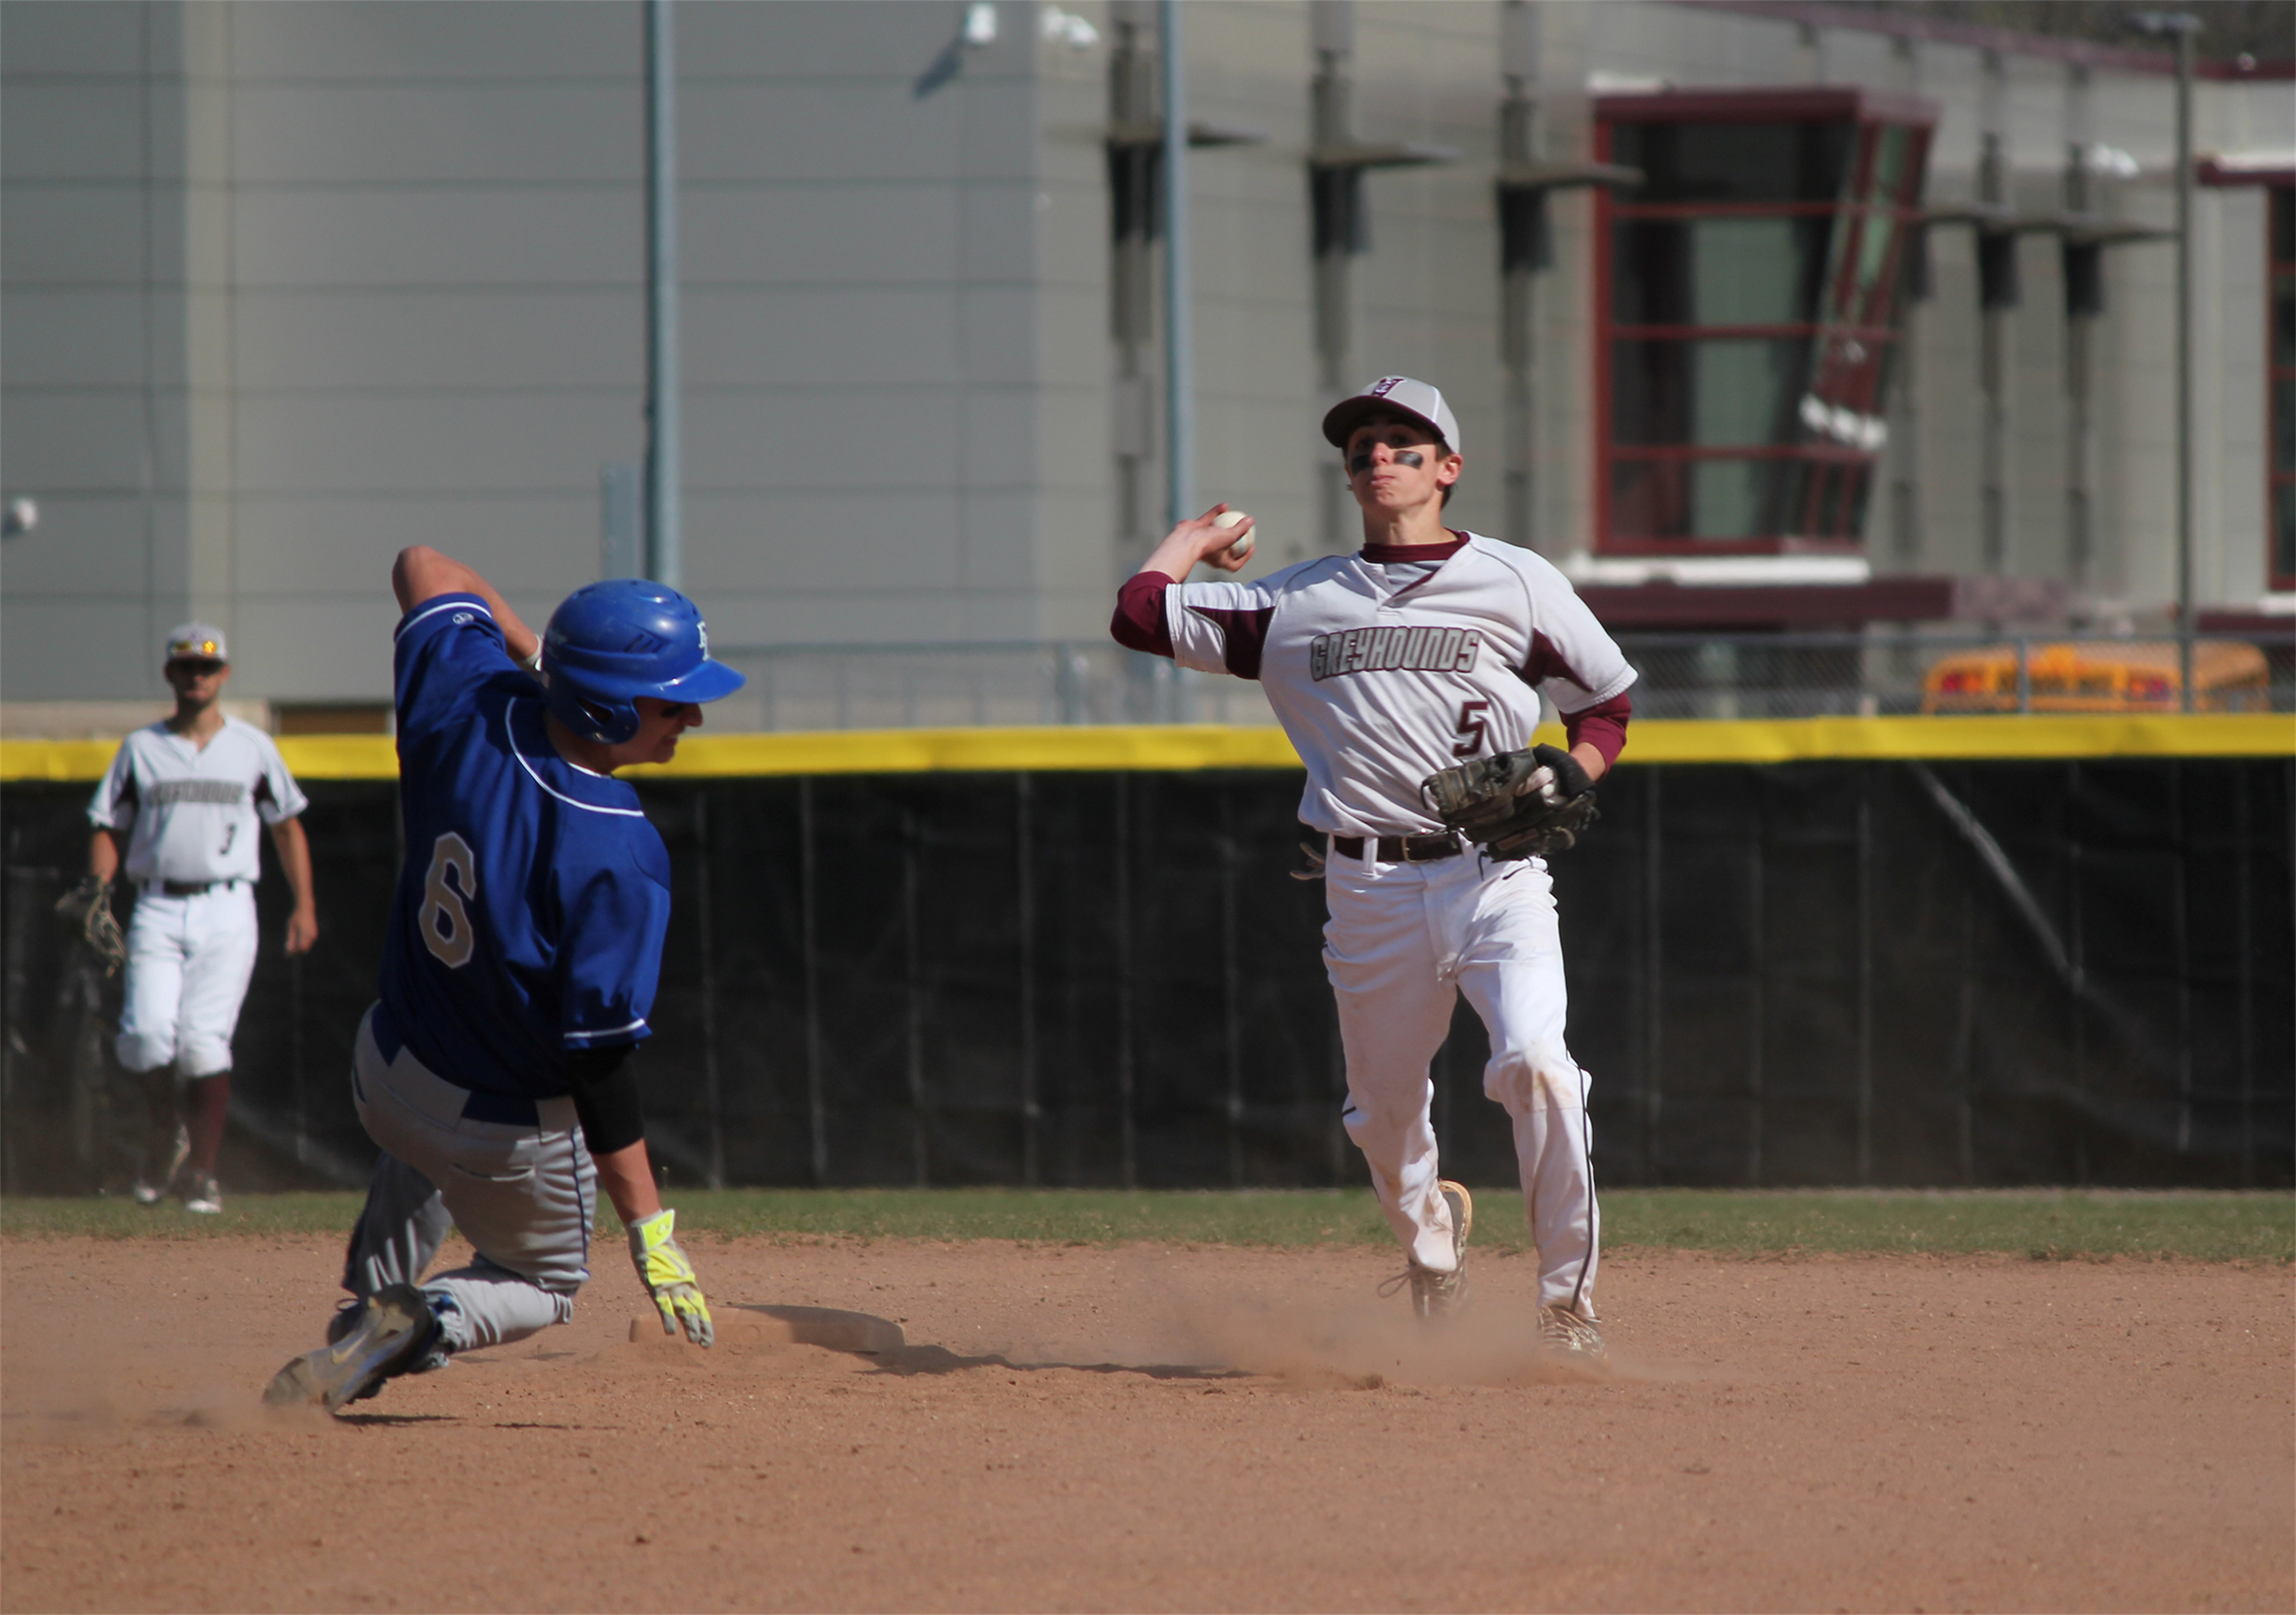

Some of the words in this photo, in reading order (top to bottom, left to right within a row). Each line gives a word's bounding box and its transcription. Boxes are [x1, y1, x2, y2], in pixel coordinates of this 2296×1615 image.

[1310, 626, 1481, 682] GREYHOUNDS
[1452, 701, 1489, 757] 5
[419, 832, 476, 969] 6
